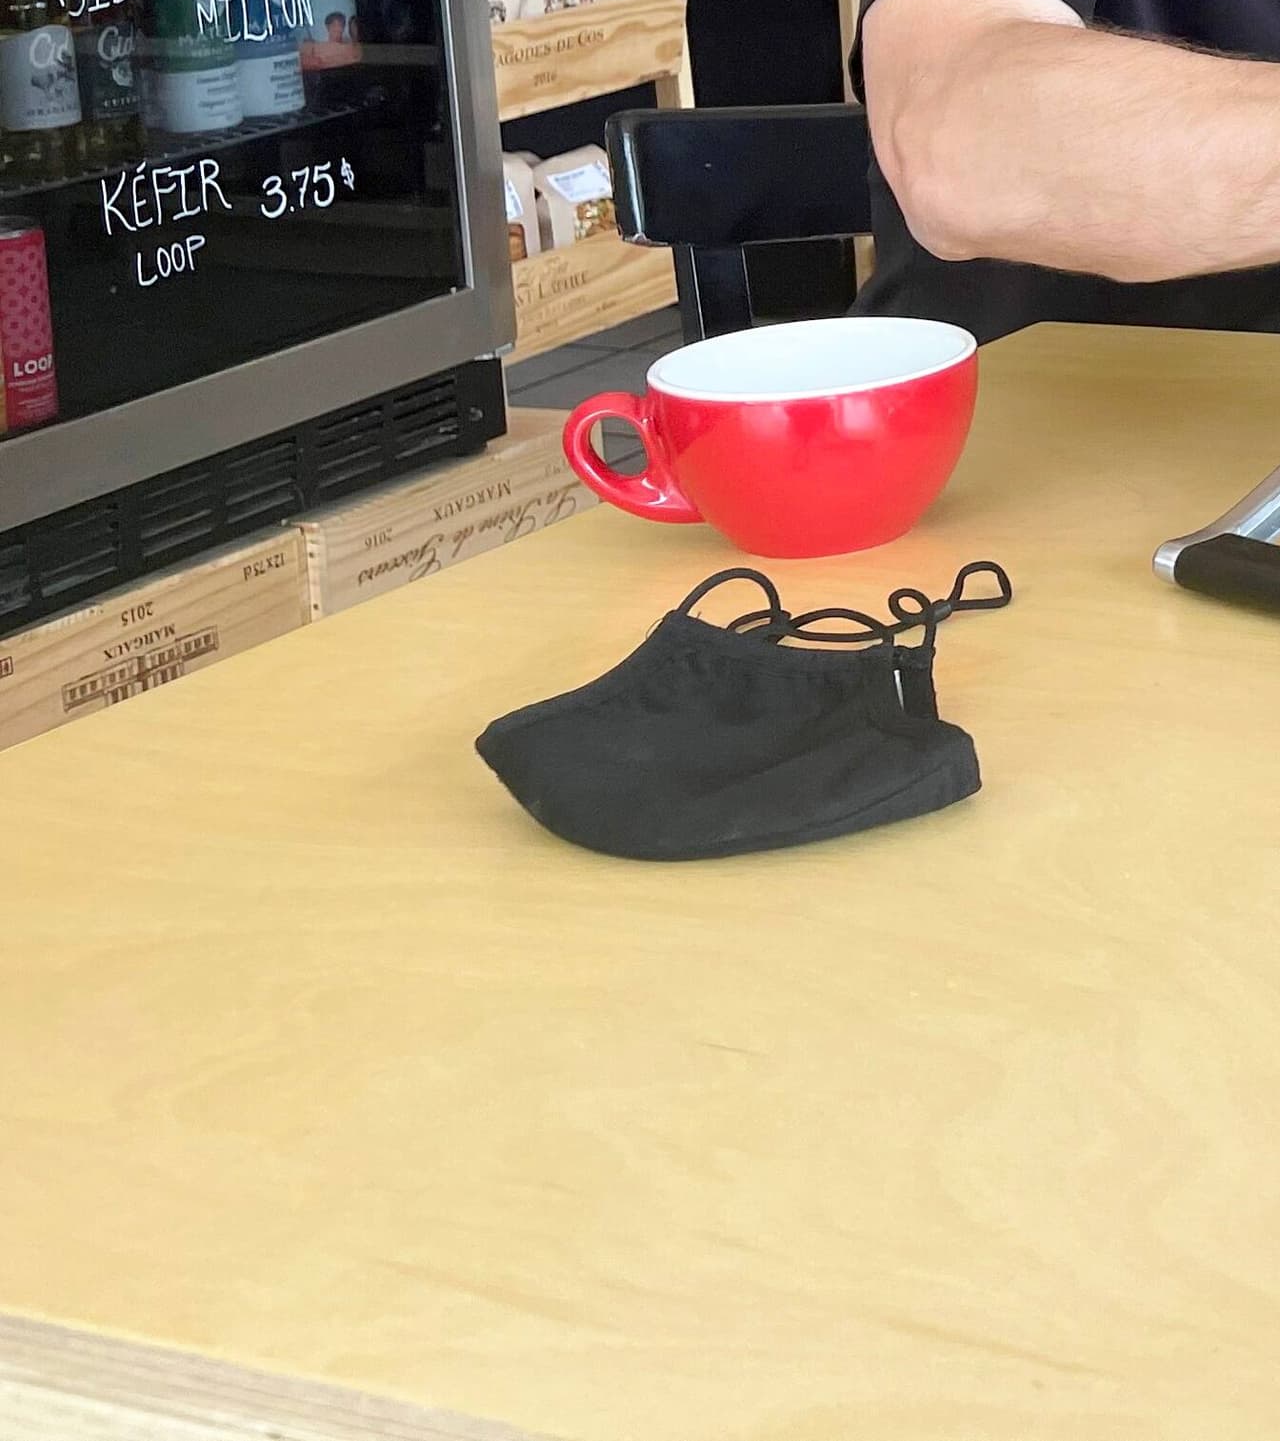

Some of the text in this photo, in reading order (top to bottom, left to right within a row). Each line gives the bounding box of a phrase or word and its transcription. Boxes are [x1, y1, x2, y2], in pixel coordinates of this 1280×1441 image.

[100, 157, 356, 236] KÉFIR 3.75$
[137, 234, 206, 287] LOOP
[432, 479, 513, 523] MARGAUX
[363, 526, 394, 550] 2016
[119, 601, 155, 627] 2015
[103, 622, 177, 662] MARGAUX
